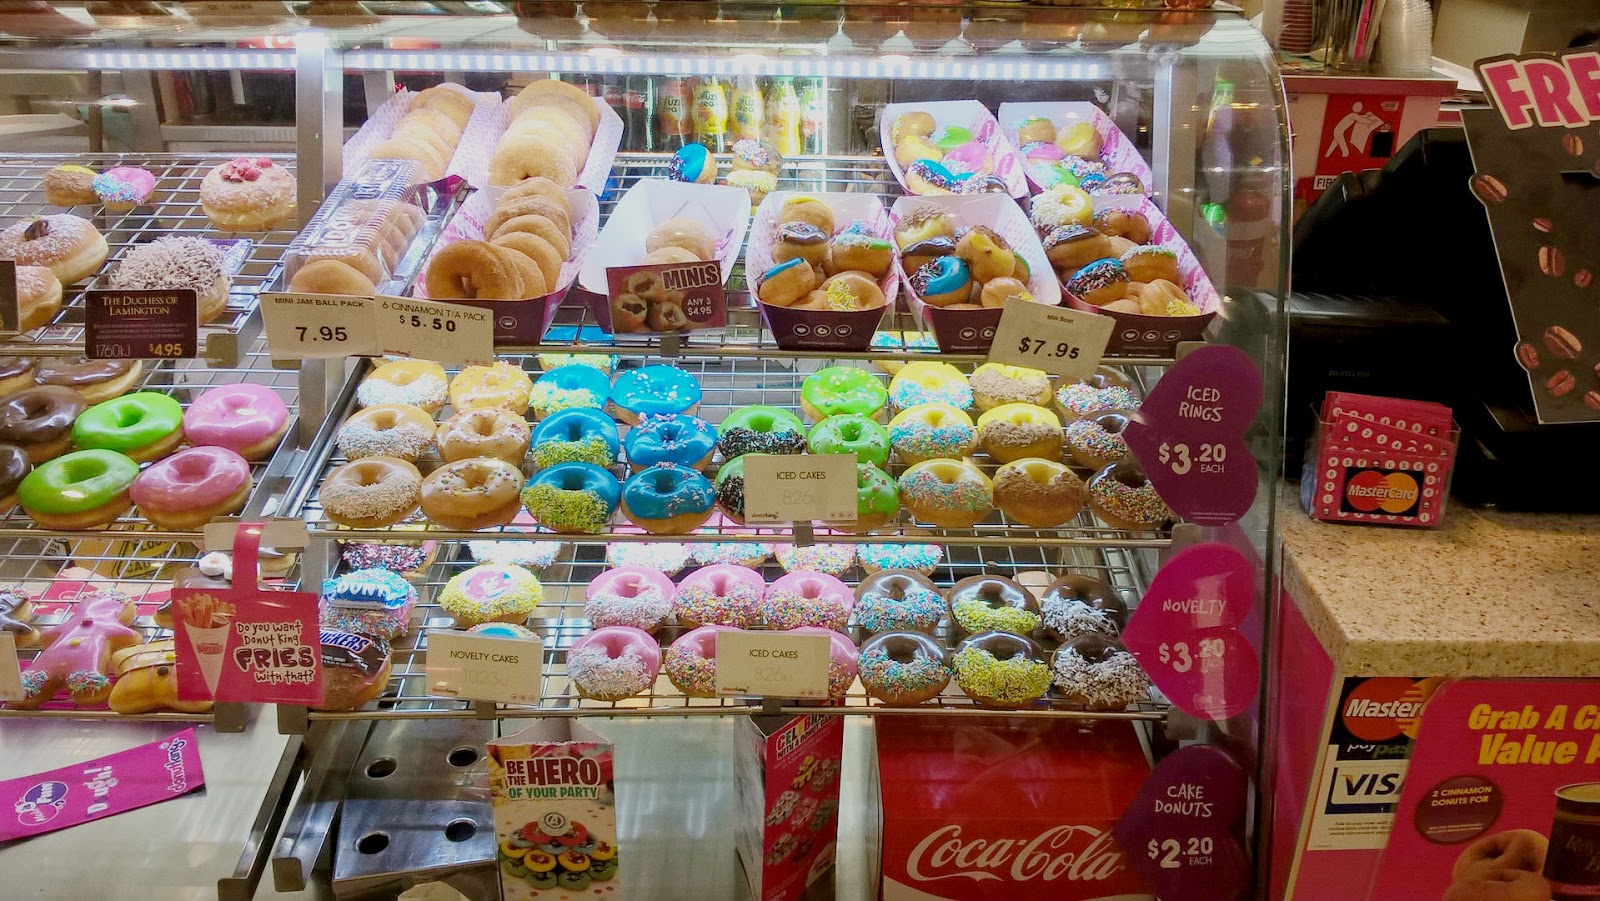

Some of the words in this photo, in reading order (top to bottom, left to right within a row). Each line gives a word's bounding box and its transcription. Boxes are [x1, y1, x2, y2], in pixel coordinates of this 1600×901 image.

[1317, 178, 1336, 188] FIR
[661, 264, 720, 291] MINIS
[101, 296, 121, 306] THE
[122, 296, 165, 306] DUCHESS
[165, 296, 179, 305] OF
[315, 299, 338, 307] BALL
[687, 298, 704, 306] ANY
[706, 297, 712, 305] 3
[109, 306, 170, 316] LAMINGTON
[382, 301, 389, 309] 6
[391, 302, 444, 317] CINNAMON
[445, 309, 461, 319] T/A
[463, 312, 486, 322] PACK
[687, 307, 712, 316] $4.95
[295, 326, 348, 342] 7.95
[149, 343, 182, 357] $4.95
[1018, 336, 1080, 359] $7.95
[1187, 385, 1221, 402] ICED
[1178, 401, 1224, 422] RINGS
[776, 471, 797, 480] ICED
[799, 471, 826, 480] CAKES
[1200, 464, 1225, 474] EACH
[1348, 485, 1416, 500] MasterCard
[1162, 598, 1228, 616] NOVELTY
[237, 623, 250, 633] Do
[252, 623, 270, 635] you
[272, 621, 302, 634] want
[243, 634, 275, 647] Donut
[277, 633, 299, 646] King
[320, 631, 370, 652] ICKERS
[235, 646, 315, 671] FRIES
[450, 650, 490, 661] NOVELTY
[491, 653, 520, 664] CAKES
[749, 649, 770, 658] ICED
[771, 649, 799, 659] CAKES
[255, 670, 282, 684] with
[284, 669, 315, 684] that?
[1345, 698, 1424, 719] Master
[1467, 703, 1541, 730] Grab
[1544, 704, 1568, 730] A
[1478, 733, 1579, 765] Value
[506, 760, 525, 775] BE
[526, 758, 599, 786] HERO
[507, 775, 526, 786] THE
[1342, 773, 1405, 796] VIS
[508, 787, 523, 799] OF
[526, 787, 557, 798] YOUR
[560, 787, 599, 799] PARTY
[1167, 783, 1204, 799] CAKE
[1432, 790, 1439, 798] 2
[1441, 786, 1493, 797] CINNAMON
[1154, 799, 1214, 818] DONUTS
[1431, 797, 1468, 807] DONUTS
[1470, 795, 1490, 804] FOR
[906, 824, 1124, 882] Coca-Cola
[1189, 856, 1213, 866] EACH
